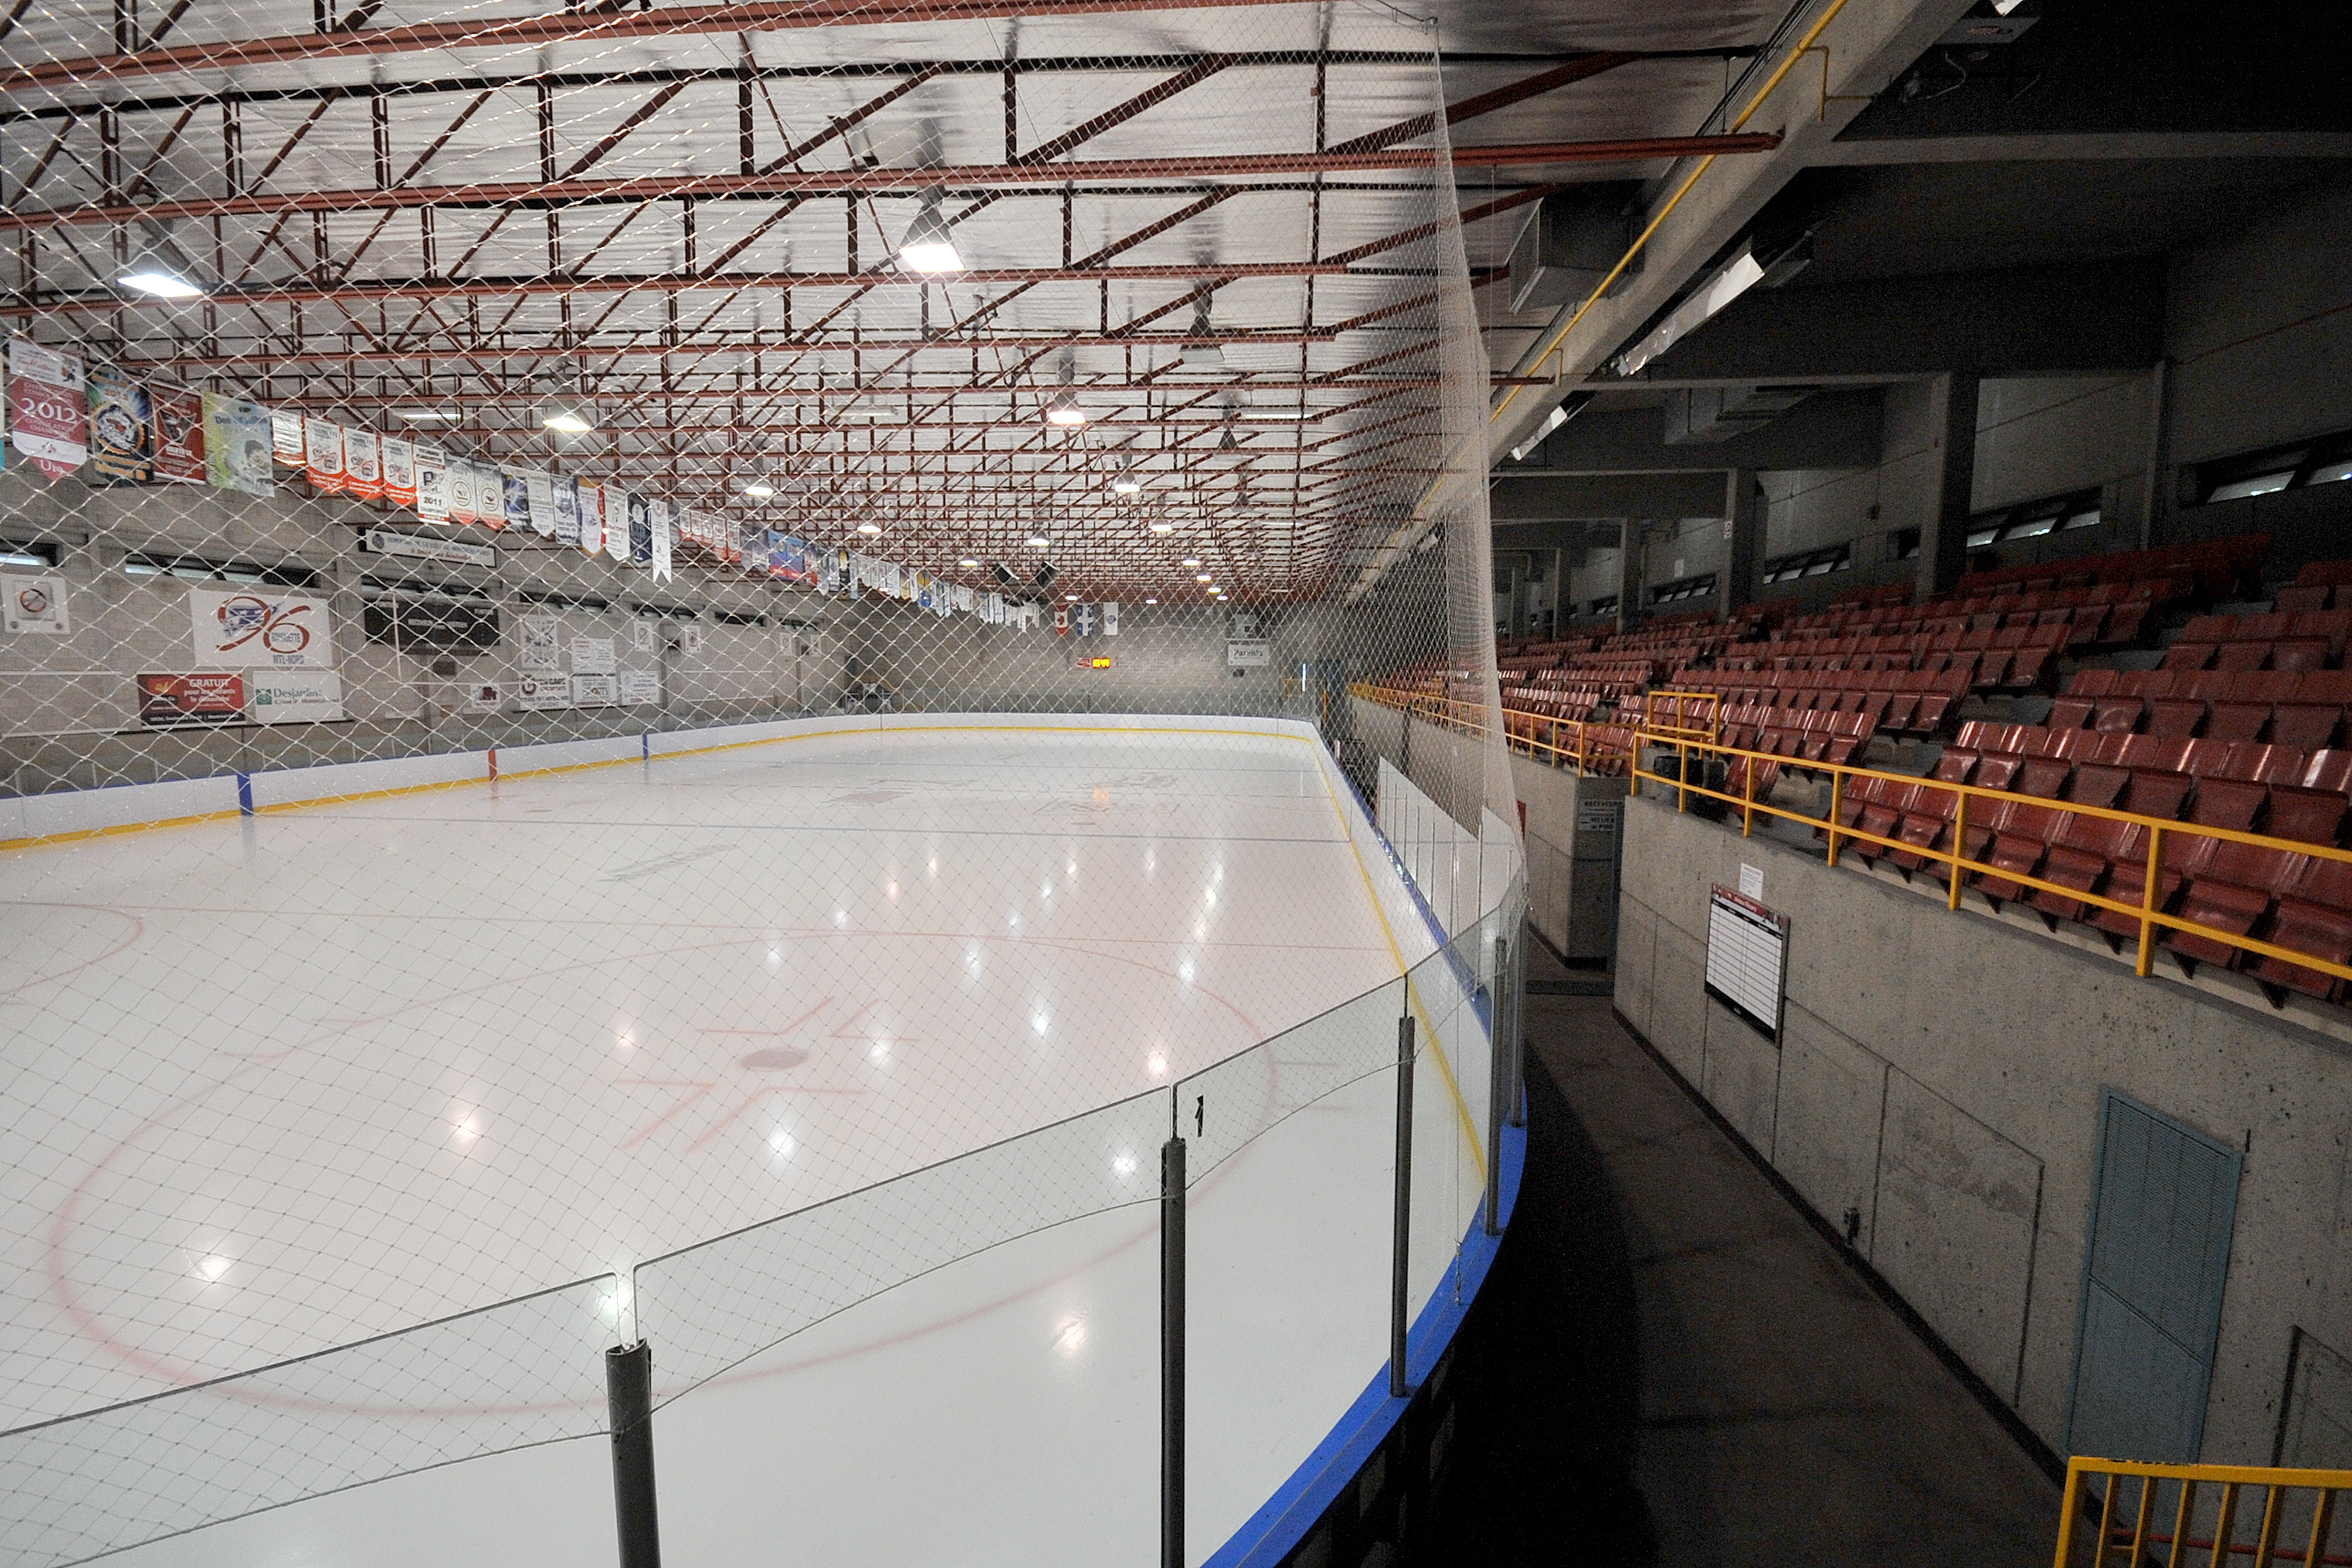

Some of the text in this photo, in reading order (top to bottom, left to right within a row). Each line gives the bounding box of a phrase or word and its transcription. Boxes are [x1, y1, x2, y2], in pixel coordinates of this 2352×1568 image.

[21, 397, 77, 423] 2012
[40, 459, 64, 476] U19
[423, 496, 442, 506] 2011
[274, 688, 322, 699] Desjardins
